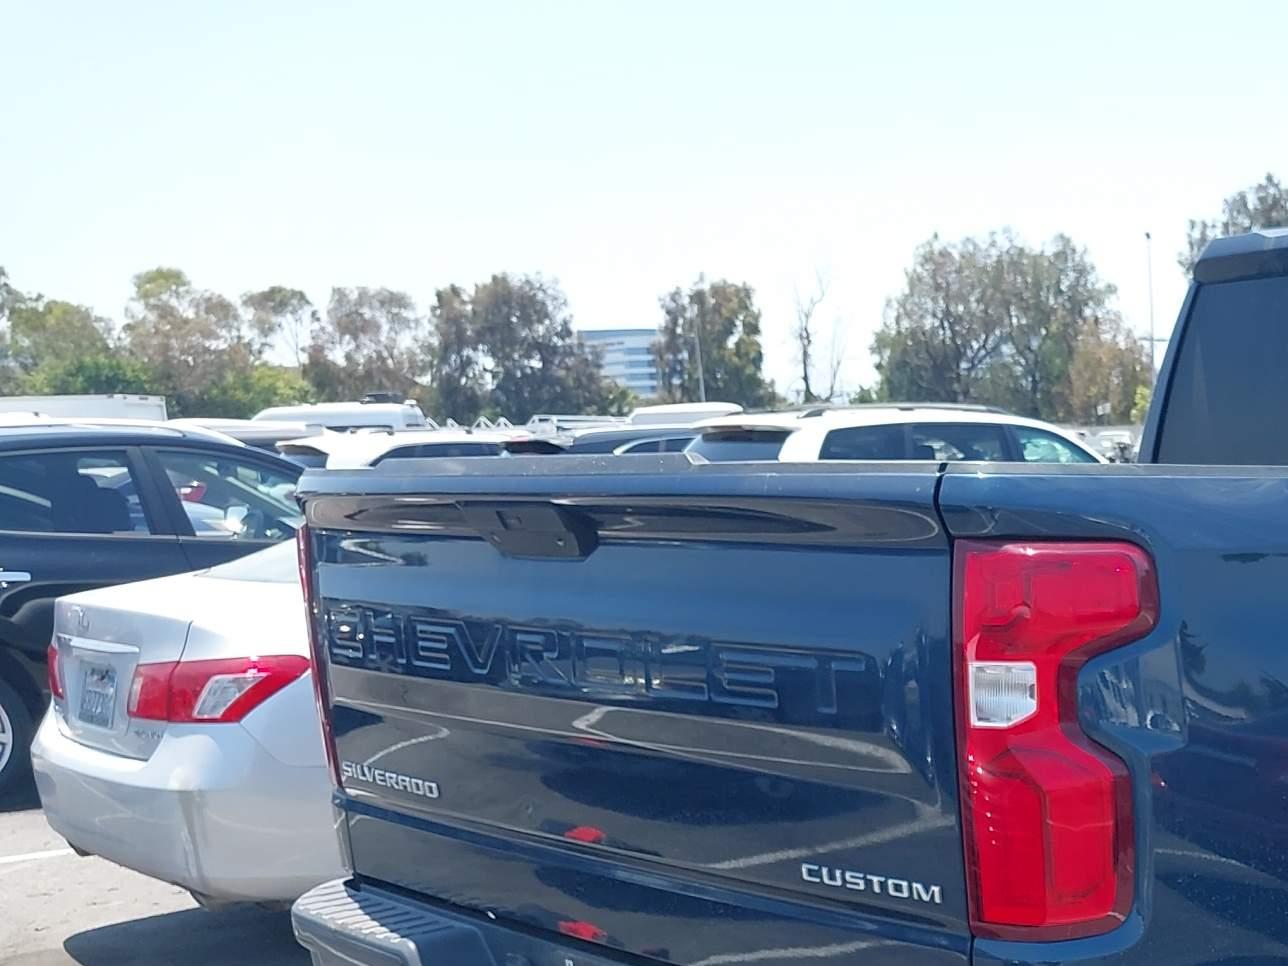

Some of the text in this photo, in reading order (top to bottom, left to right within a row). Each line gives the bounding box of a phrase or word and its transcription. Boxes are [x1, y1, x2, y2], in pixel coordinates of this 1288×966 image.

[330, 607, 867, 714] CHEVROLET
[342, 761, 440, 798] SILVERADO
[801, 863, 943, 904] CUSTOM
